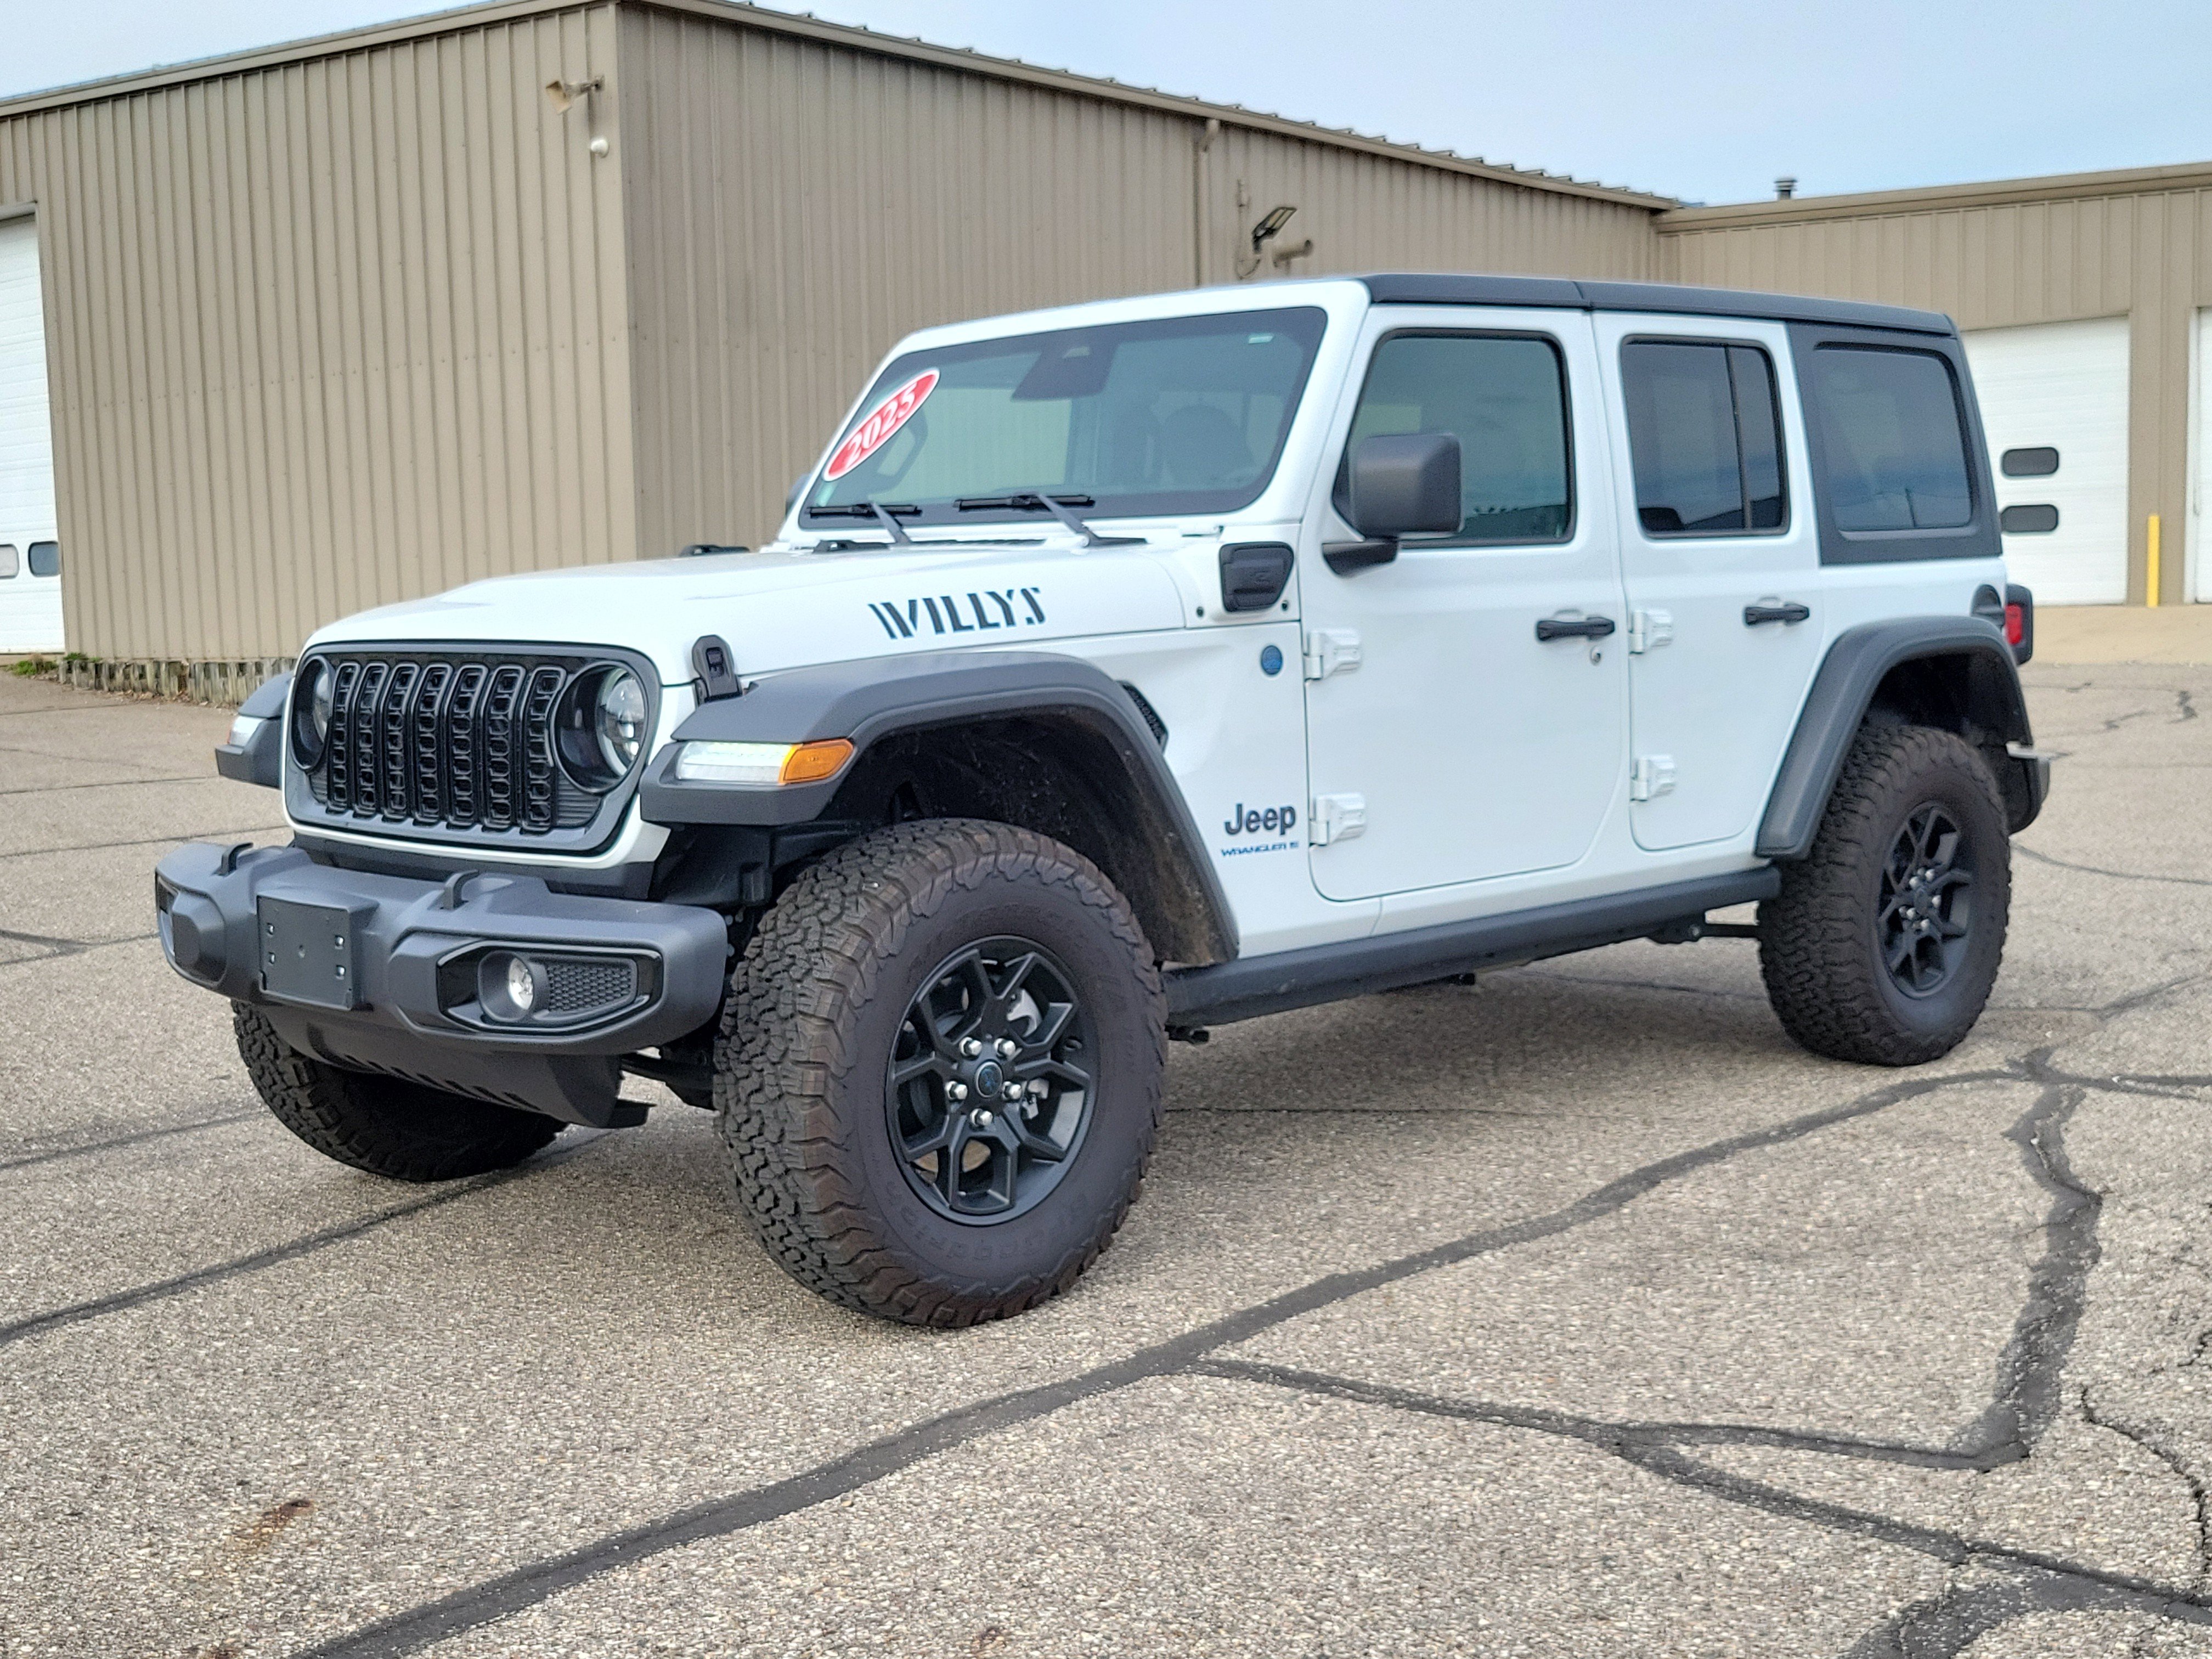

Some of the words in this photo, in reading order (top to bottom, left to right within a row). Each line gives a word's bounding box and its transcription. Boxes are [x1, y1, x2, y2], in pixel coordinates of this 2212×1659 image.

[845, 382, 918, 469] 2025
[867, 587, 1046, 640] WILLYS
[1224, 803, 1296, 836] Jeep
